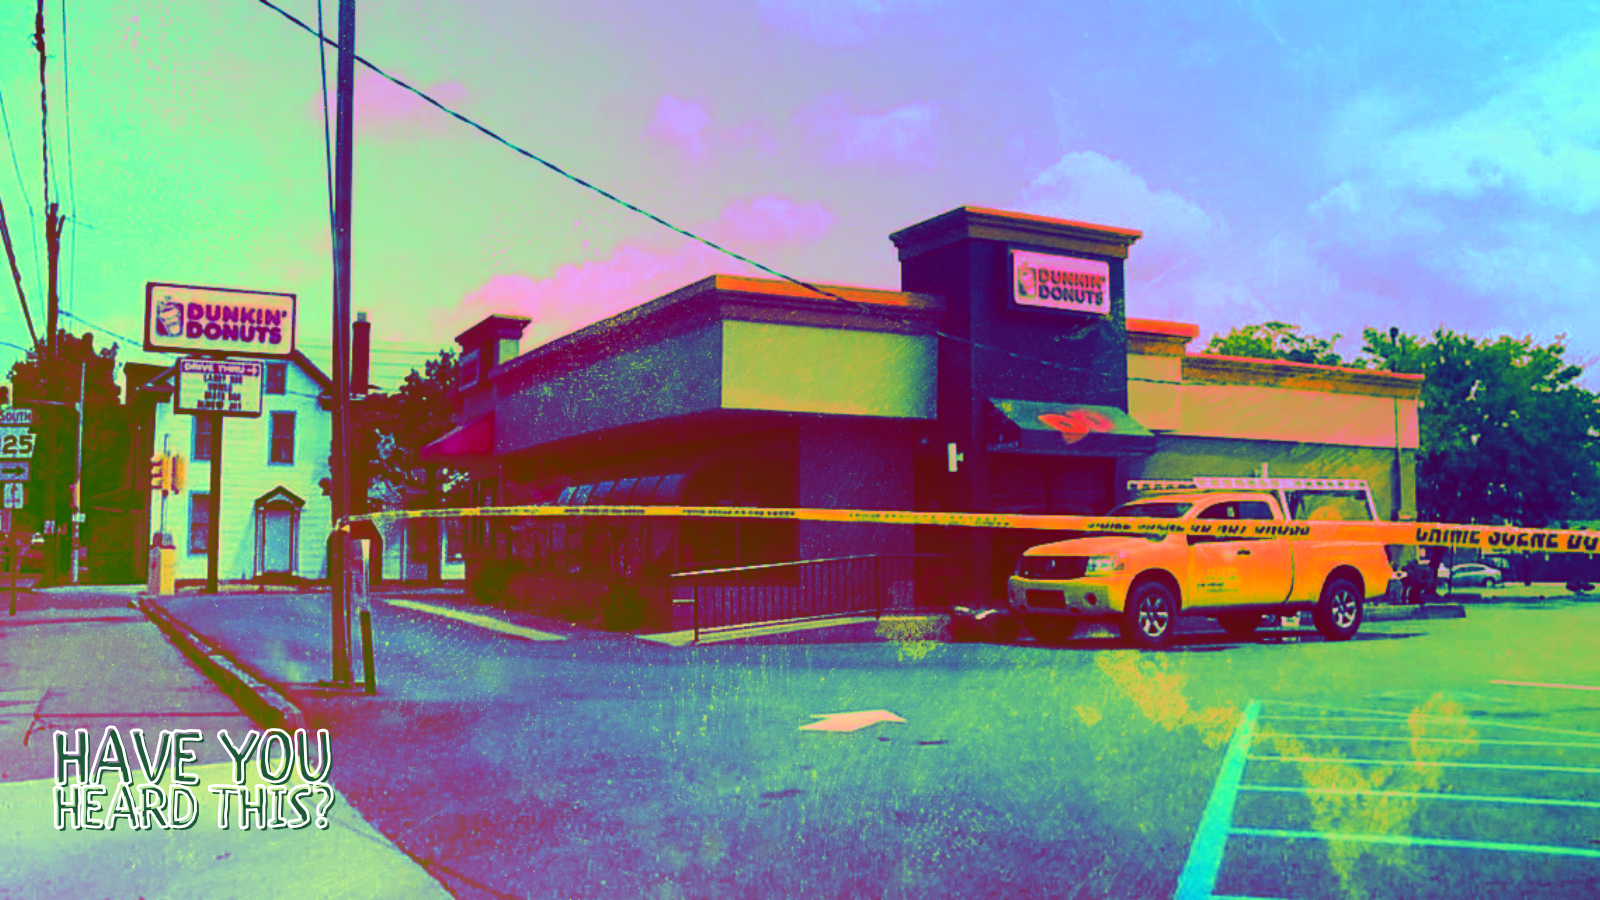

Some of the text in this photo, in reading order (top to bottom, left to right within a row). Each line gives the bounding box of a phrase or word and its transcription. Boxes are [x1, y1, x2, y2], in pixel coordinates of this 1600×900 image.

[1038, 267, 1106, 289] DUNKIN'
[1038, 284, 1103, 306] DONUTS
[187, 302, 288, 327] DUNKIN'
[186, 320, 283, 345] DONUTS
[0, 411, 32, 421] SOUTH
